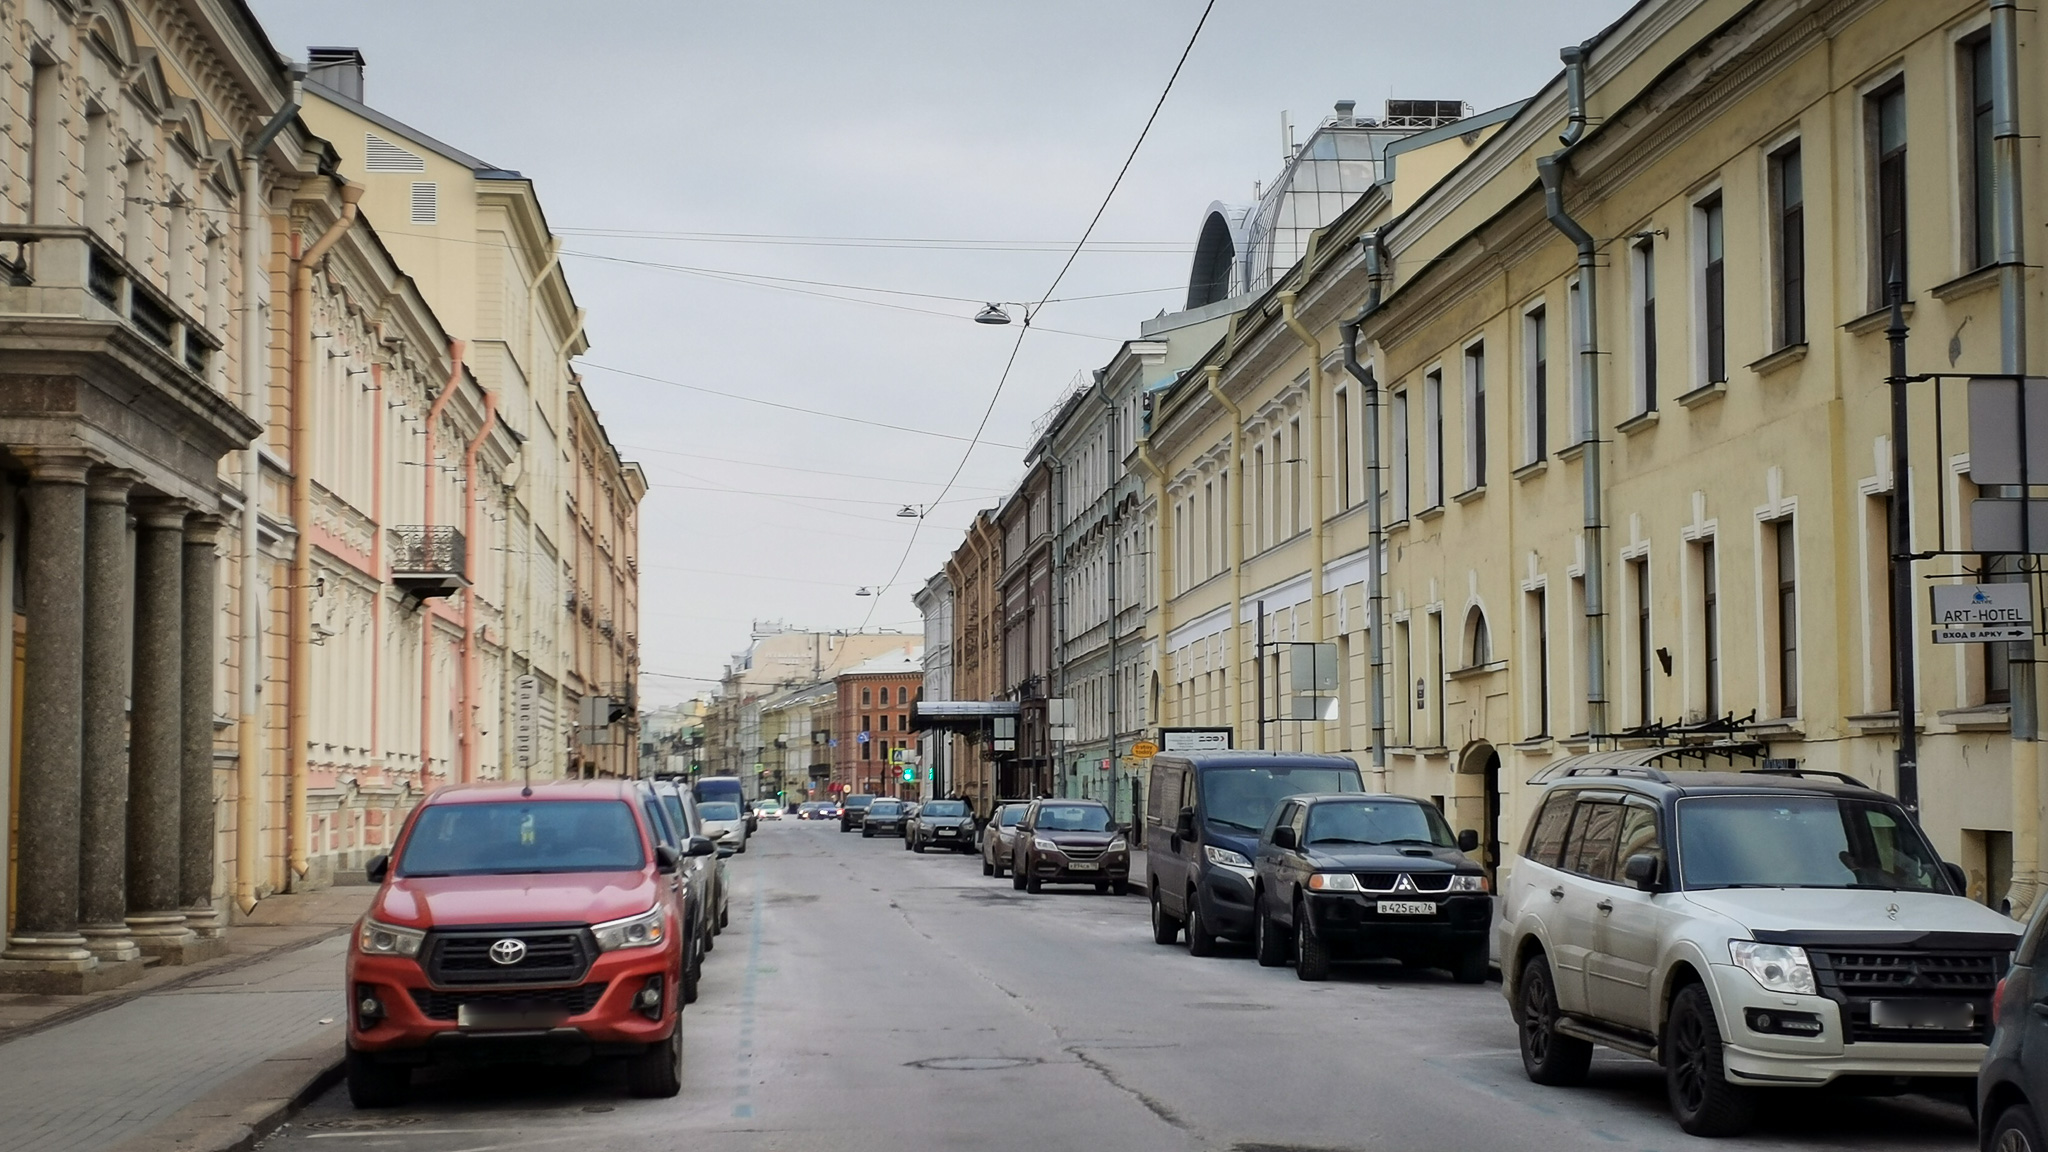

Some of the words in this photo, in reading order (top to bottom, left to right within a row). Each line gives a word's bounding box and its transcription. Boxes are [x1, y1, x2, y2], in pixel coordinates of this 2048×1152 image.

[1944, 608, 2023, 622] ART-HOTEL
[1943, 631, 1968, 639] ВХОД
[1979, 630, 2002, 638] АРКУ
